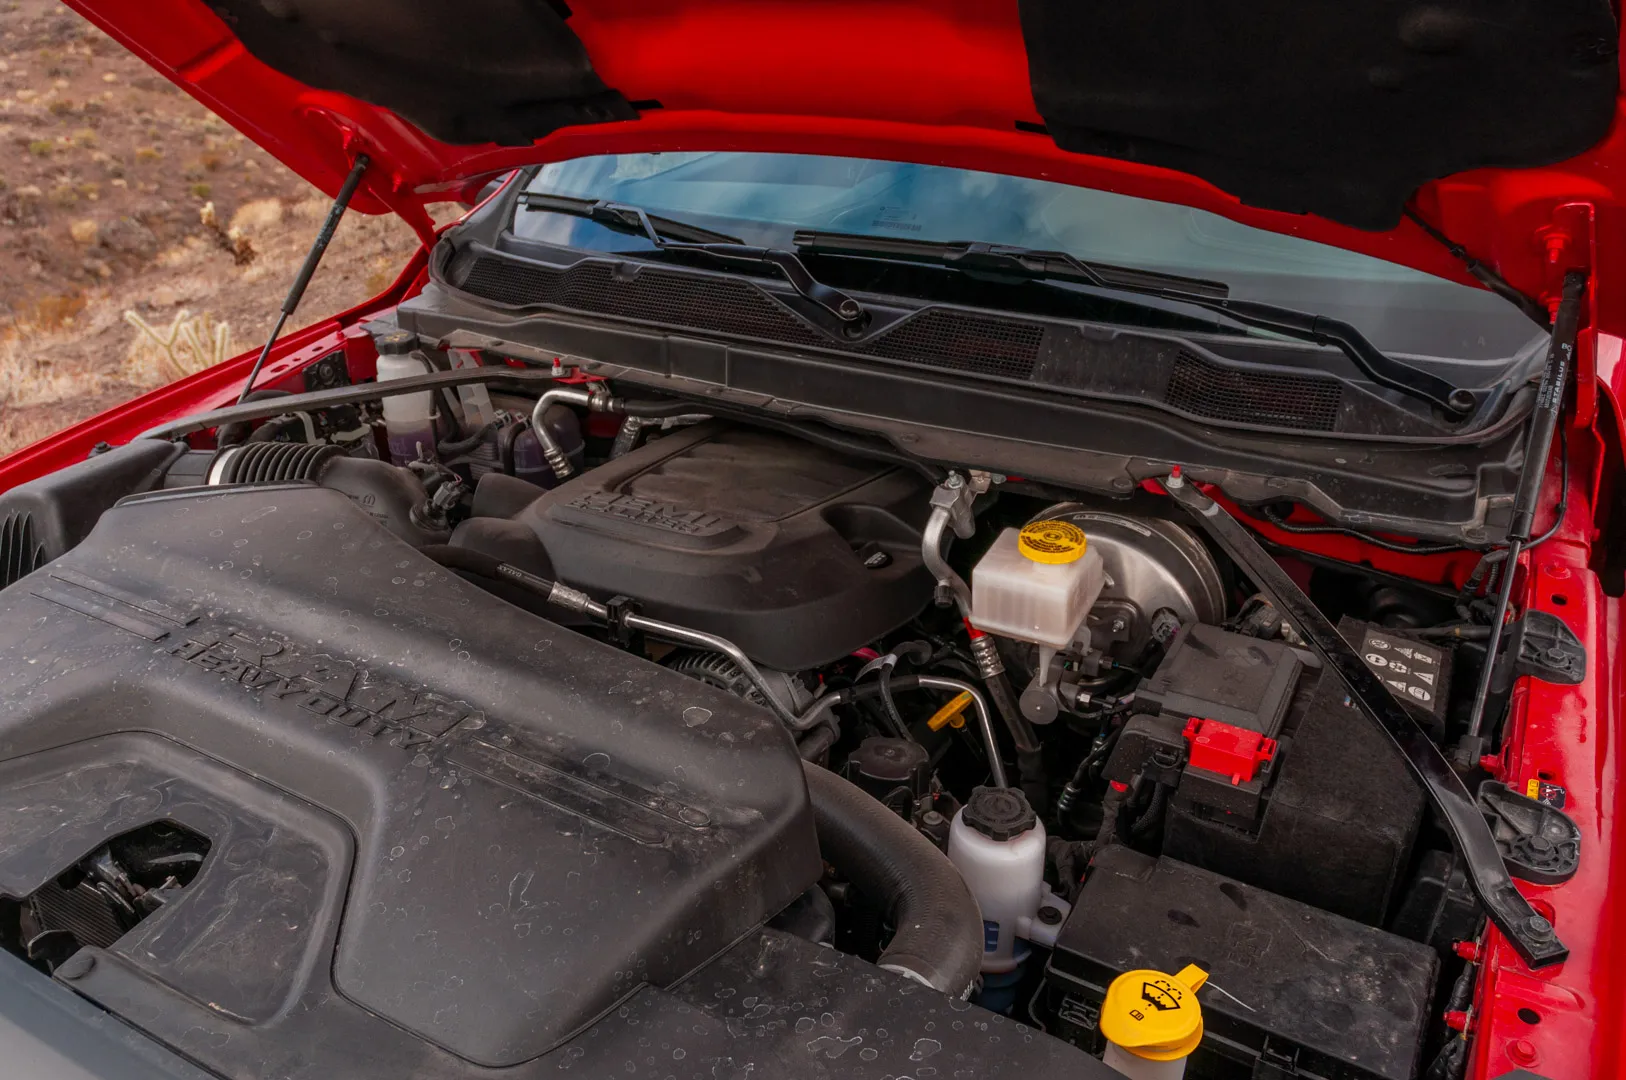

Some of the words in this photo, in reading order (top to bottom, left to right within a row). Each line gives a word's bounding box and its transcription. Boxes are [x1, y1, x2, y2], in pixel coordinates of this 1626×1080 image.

[1552, 361, 1566, 404] STABILUS
[574, 491, 721, 527] HEMI
[613, 508, 700, 533] LITER
[168, 638, 310, 699] HEAVY
[297, 698, 433, 750] DUTY
[211, 632, 469, 738] RAM
